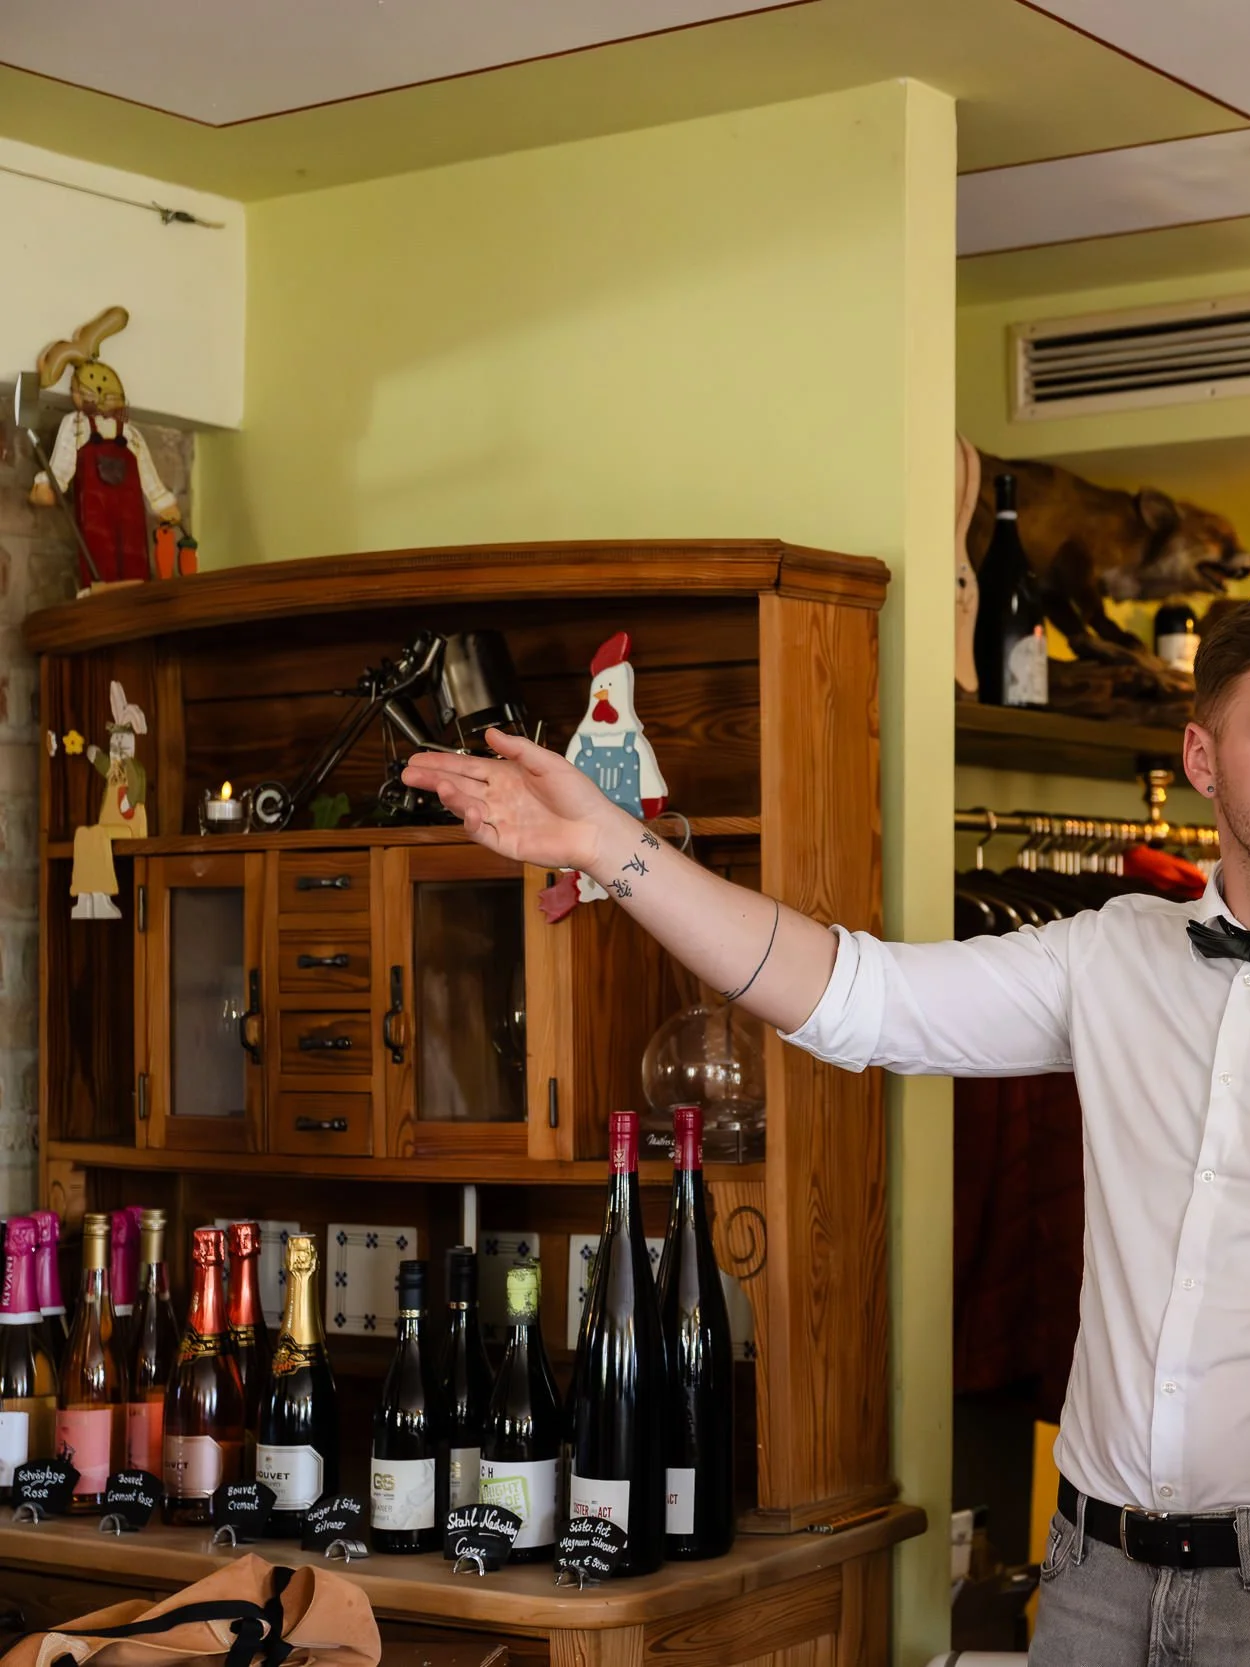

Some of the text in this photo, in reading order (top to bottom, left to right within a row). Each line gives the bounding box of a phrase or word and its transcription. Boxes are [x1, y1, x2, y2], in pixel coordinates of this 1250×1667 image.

[256, 1470, 290, 1480] OUVET
[227, 1481, 257, 1497] Bouvet
[447, 1507, 478, 1530] Stahl
[595, 1521, 611, 1538] Act
[559, 1537, 618, 1554] Magnum Silvaner
[583, 1555, 592, 1566] €
